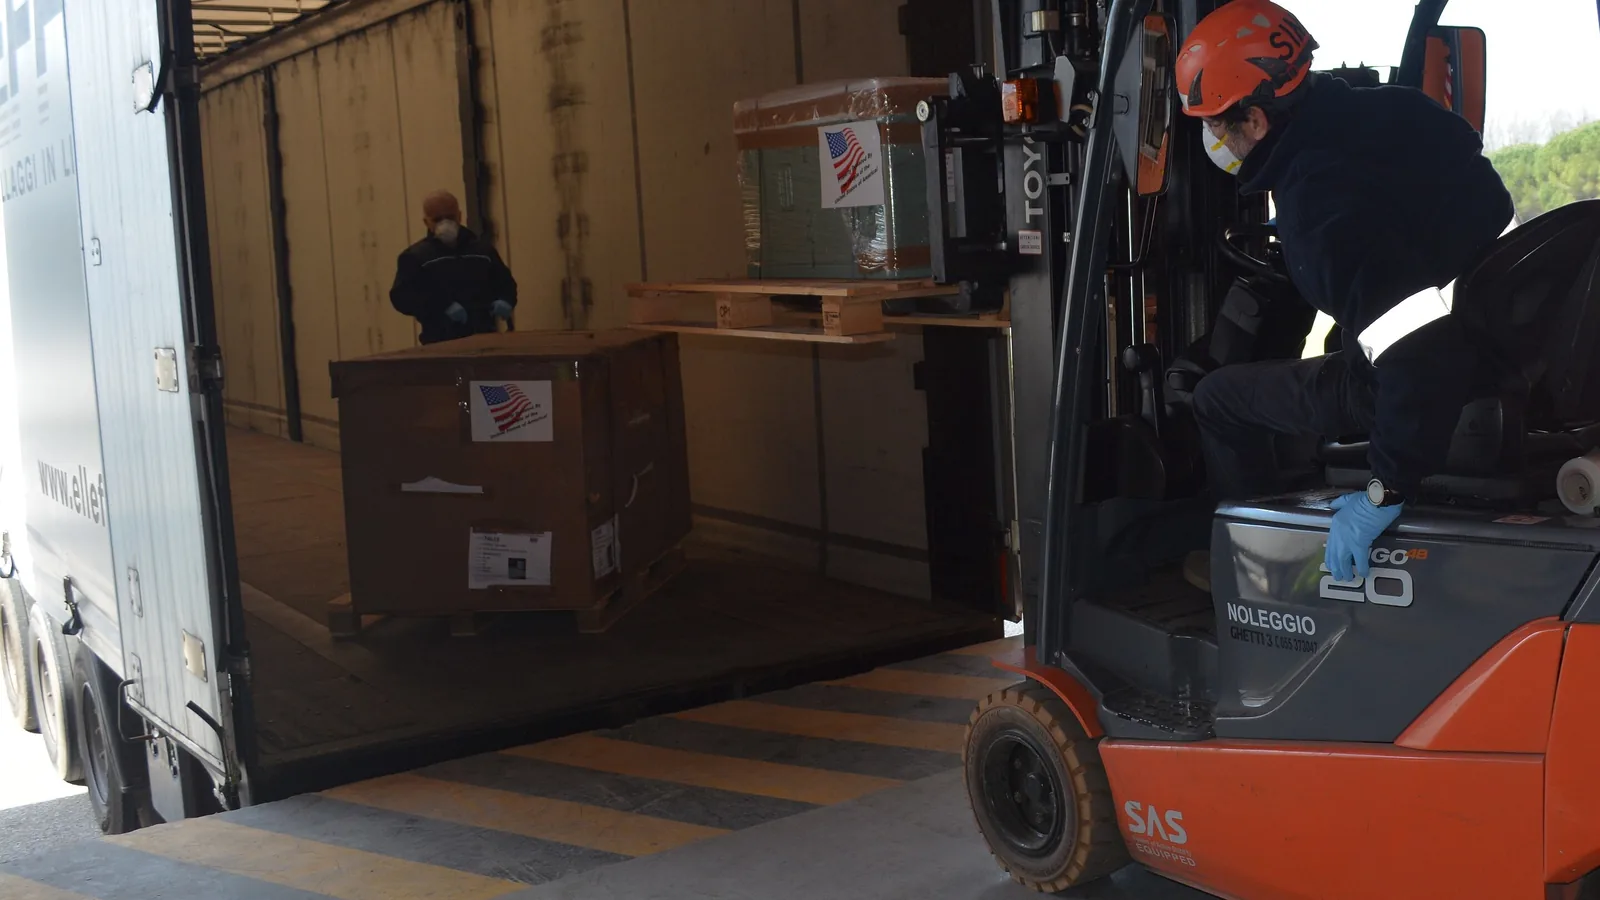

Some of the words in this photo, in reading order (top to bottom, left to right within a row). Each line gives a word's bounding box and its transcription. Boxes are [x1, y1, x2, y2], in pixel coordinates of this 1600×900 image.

[1022, 136, 1044, 224] TOY
[1319, 562, 1415, 608] 20
[1226, 602, 1316, 636] NOLEGGIO
[1124, 800, 1187, 844] SAS
[1135, 843, 1196, 867] EQUIPPED
